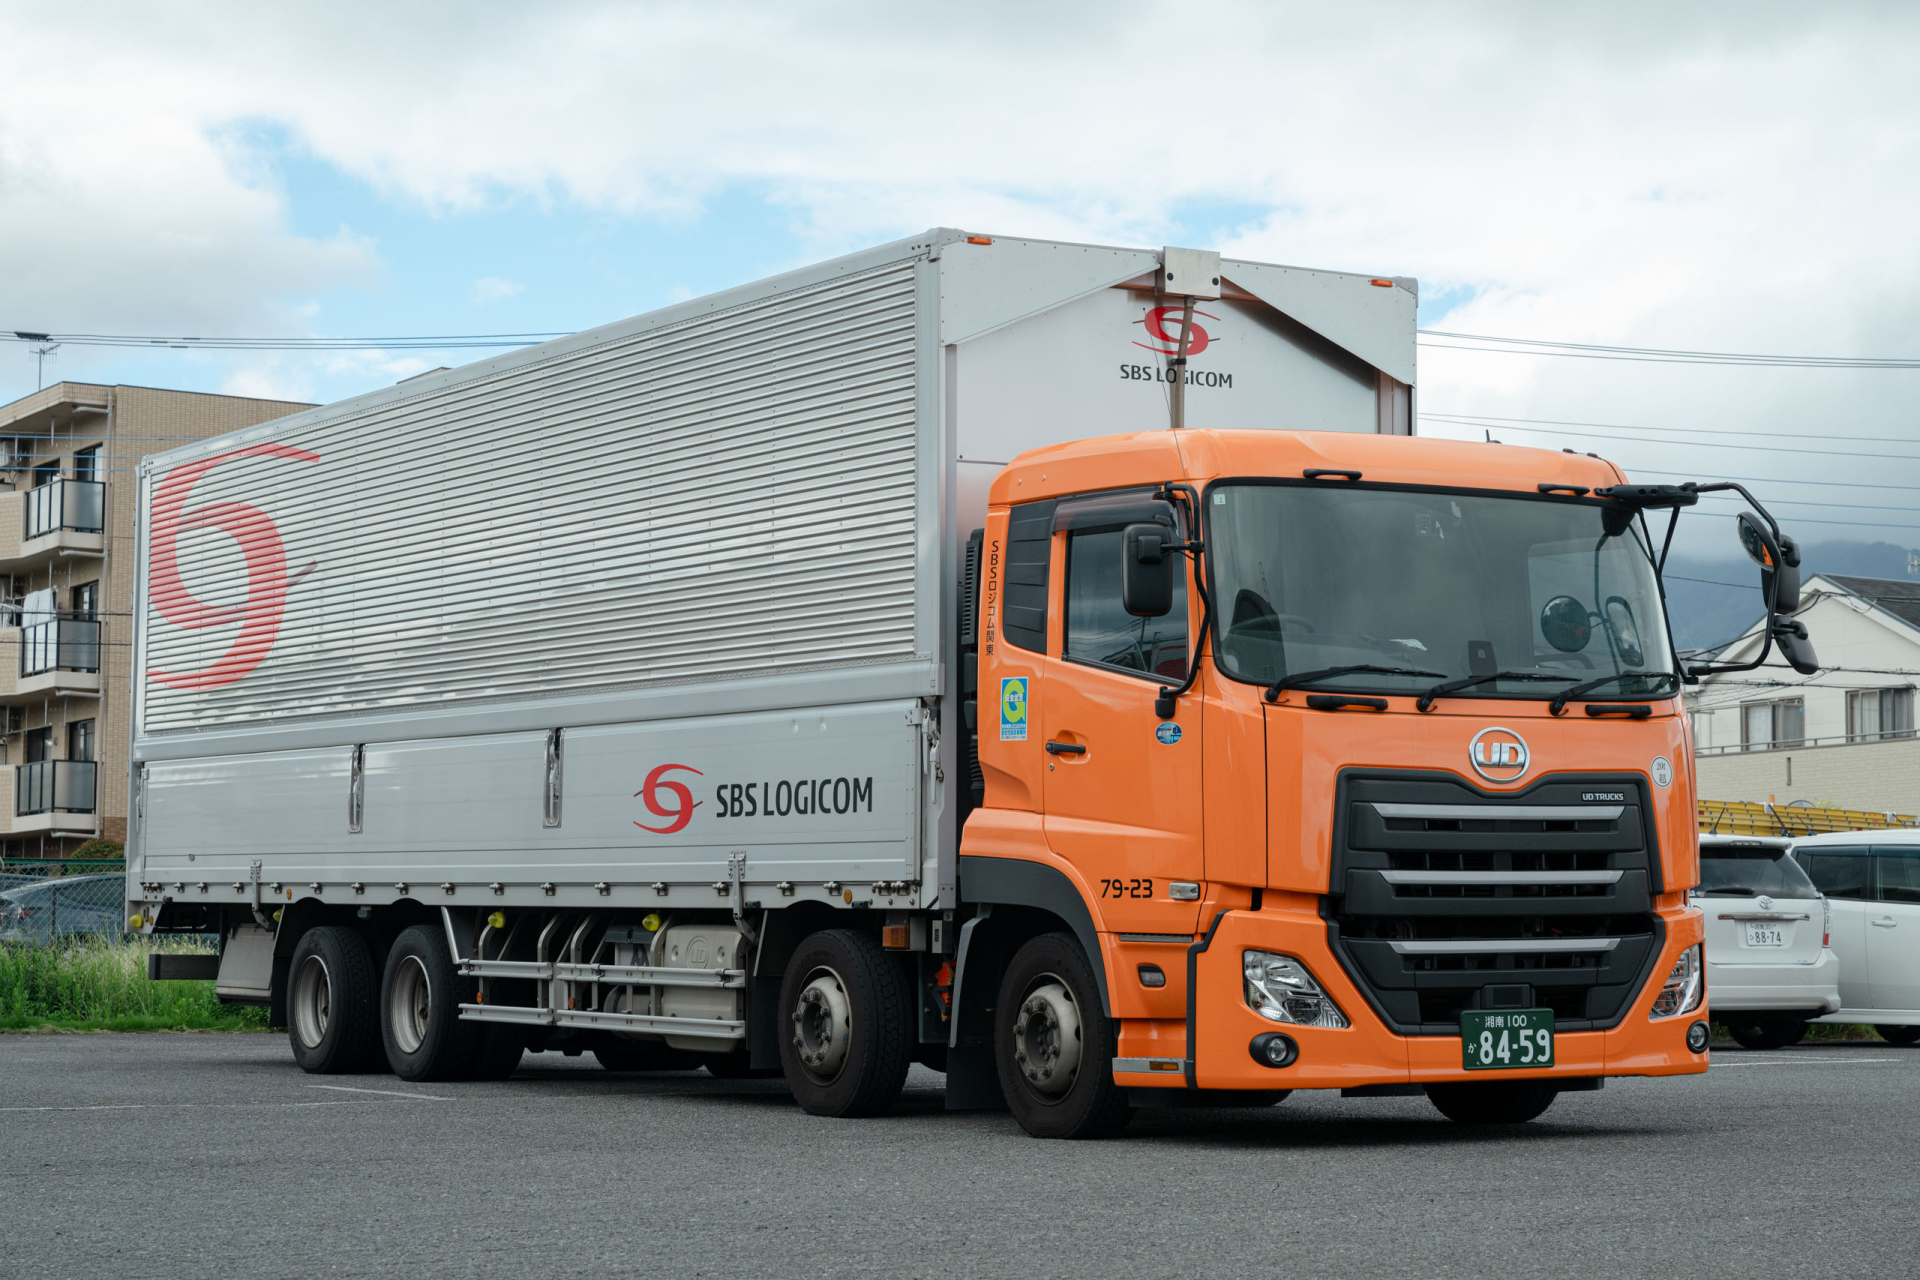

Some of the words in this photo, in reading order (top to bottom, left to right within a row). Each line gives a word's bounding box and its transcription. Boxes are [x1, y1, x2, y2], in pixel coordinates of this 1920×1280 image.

[1120, 364, 1151, 381] SBS
[985, 540, 999, 656] SBSロジコム関東
[1475, 743, 1526, 767] UD
[716, 783, 757, 818] SBS
[763, 776, 873, 817] LOGICOM
[1582, 793, 1594, 801] UD
[1595, 793, 1624, 801] TRUCKS
[1100, 878, 1153, 899] 79-23
[1755, 931, 1782, 944] 88-74
[1484, 1016, 1504, 1028] 湘南
[1507, 1015, 1527, 1027] 100
[1467, 1042, 1477, 1054] か
[1479, 1028, 1551, 1065] 84-59
